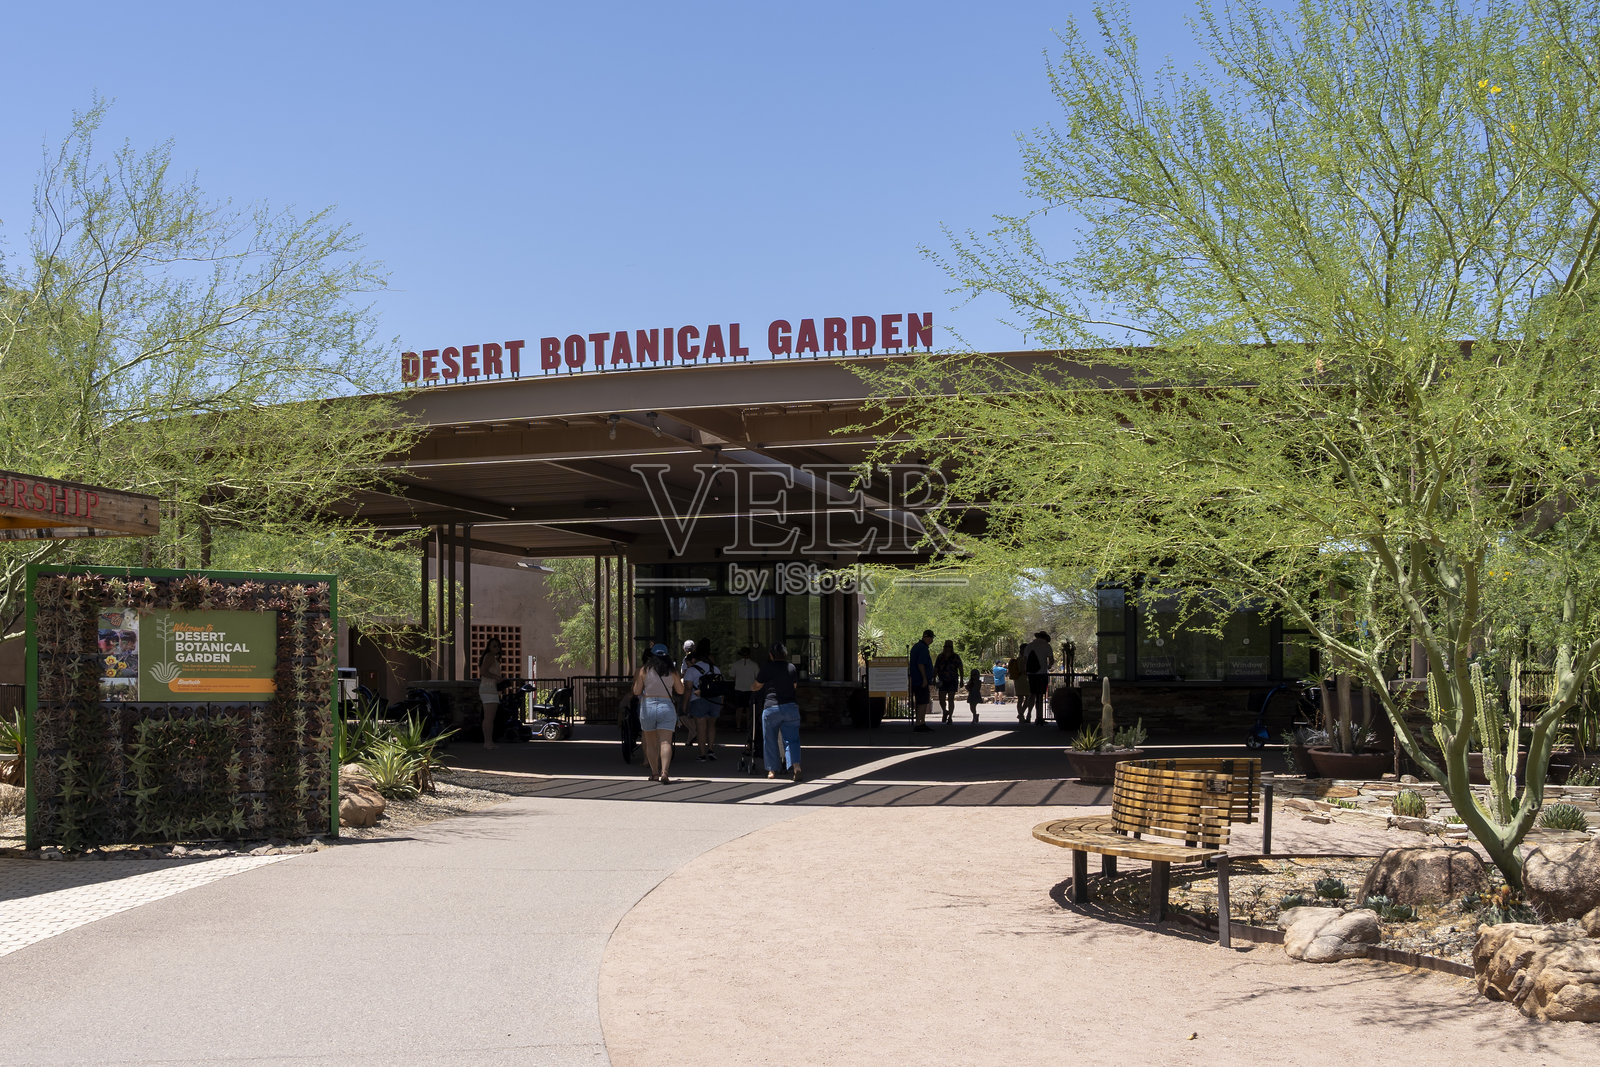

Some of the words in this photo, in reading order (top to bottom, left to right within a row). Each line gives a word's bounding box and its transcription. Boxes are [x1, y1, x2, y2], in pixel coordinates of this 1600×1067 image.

[401, 340, 525, 383] DESERT
[540, 322, 749, 371] BOTANICAL
[768, 312, 933, 355] GARDEN
[173, 622, 205, 632] Welcome
[206, 624, 213, 632] to
[175, 632, 225, 642] DESERT
[175, 642, 250, 653] BOTANICAL
[175, 653, 230, 663] GARDEN
[1142, 661, 1171, 669] Window
[1232, 661, 1263, 669] Window
